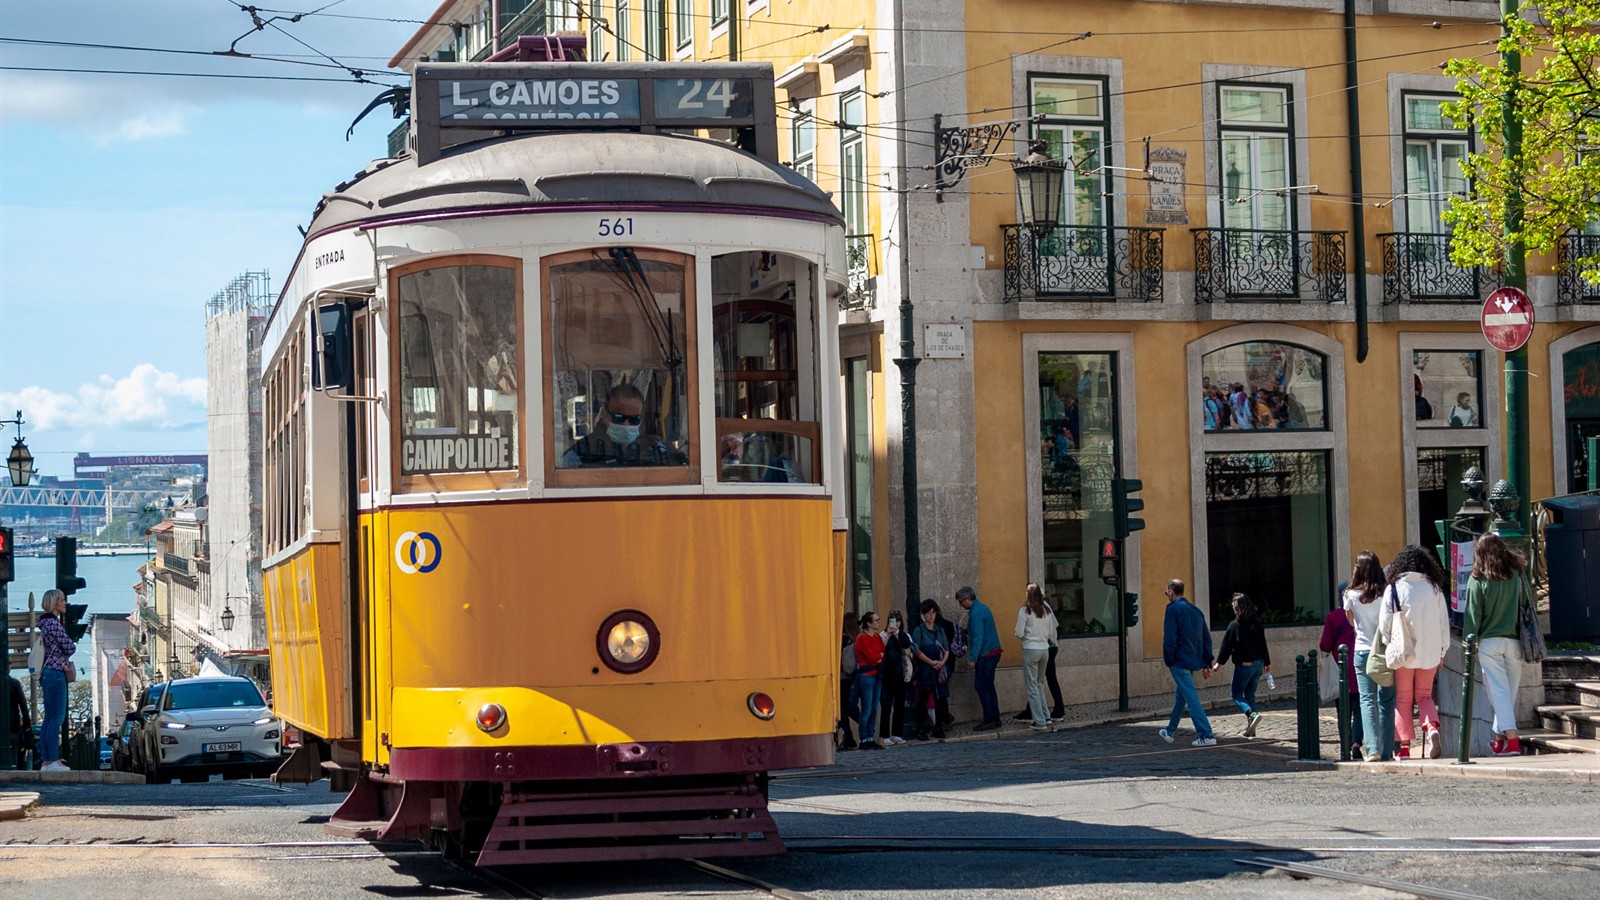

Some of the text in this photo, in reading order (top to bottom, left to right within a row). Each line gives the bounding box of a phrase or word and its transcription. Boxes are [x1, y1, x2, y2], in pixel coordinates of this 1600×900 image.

[452, 82, 478, 106] L.
[677, 79, 738, 109] 24
[1152, 166, 1180, 176] PRAÇA
[598, 217, 633, 236] 561
[315, 249, 345, 270] ENTRADA
[402, 438, 509, 471] CAMPOLIDE
